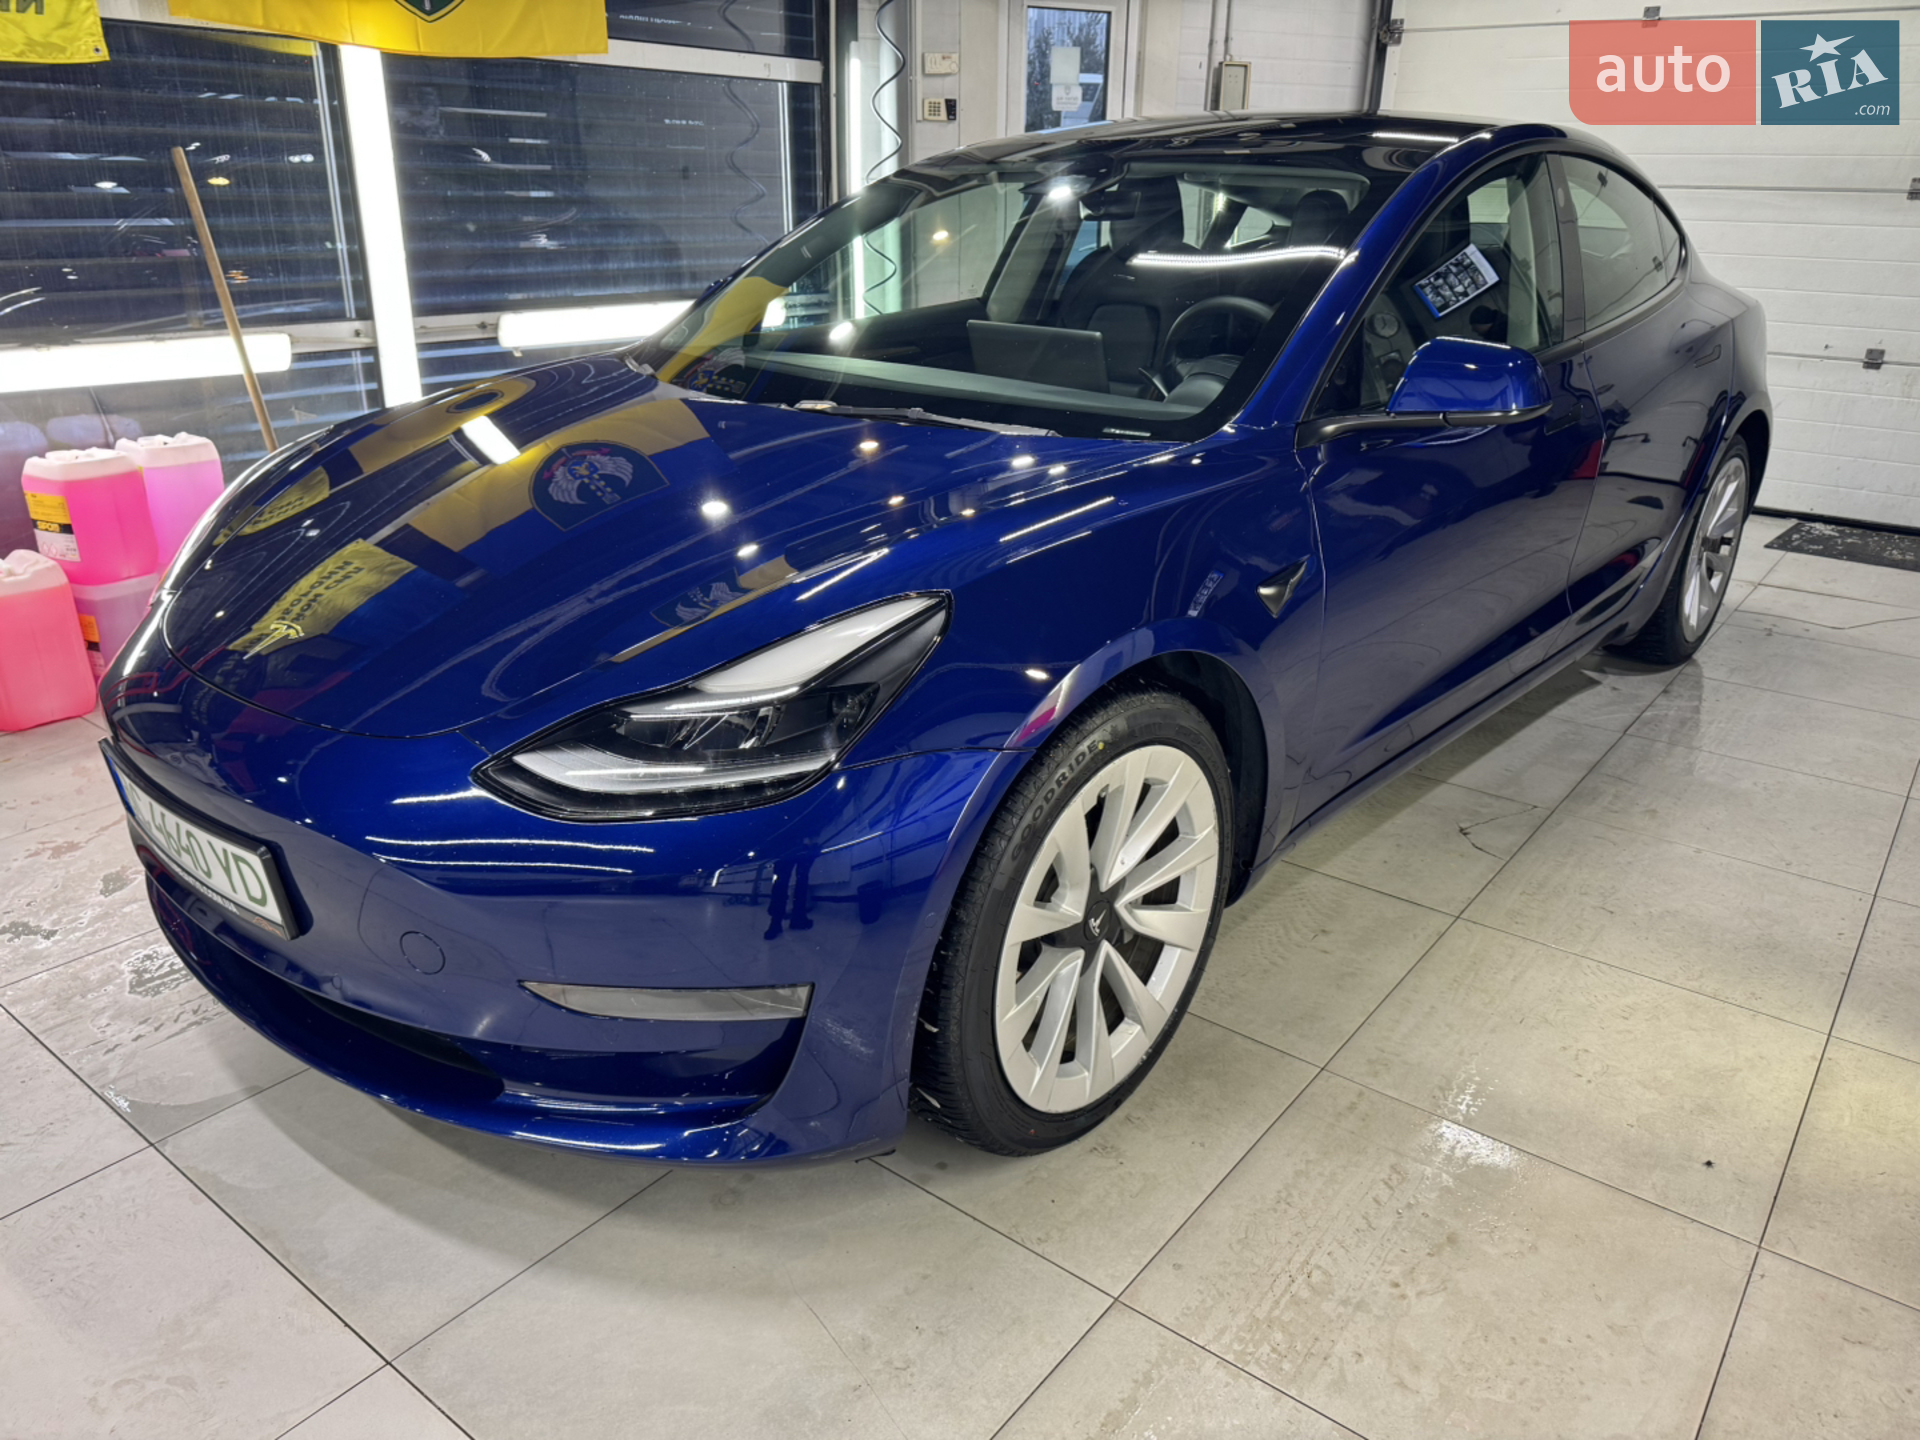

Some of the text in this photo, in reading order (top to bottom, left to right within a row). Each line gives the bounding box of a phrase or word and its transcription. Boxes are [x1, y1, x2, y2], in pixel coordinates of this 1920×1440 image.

[149, 800, 213, 880] 4640
[207, 840, 268, 908] YD
[1010, 738, 1100, 861] GOODRIDE
